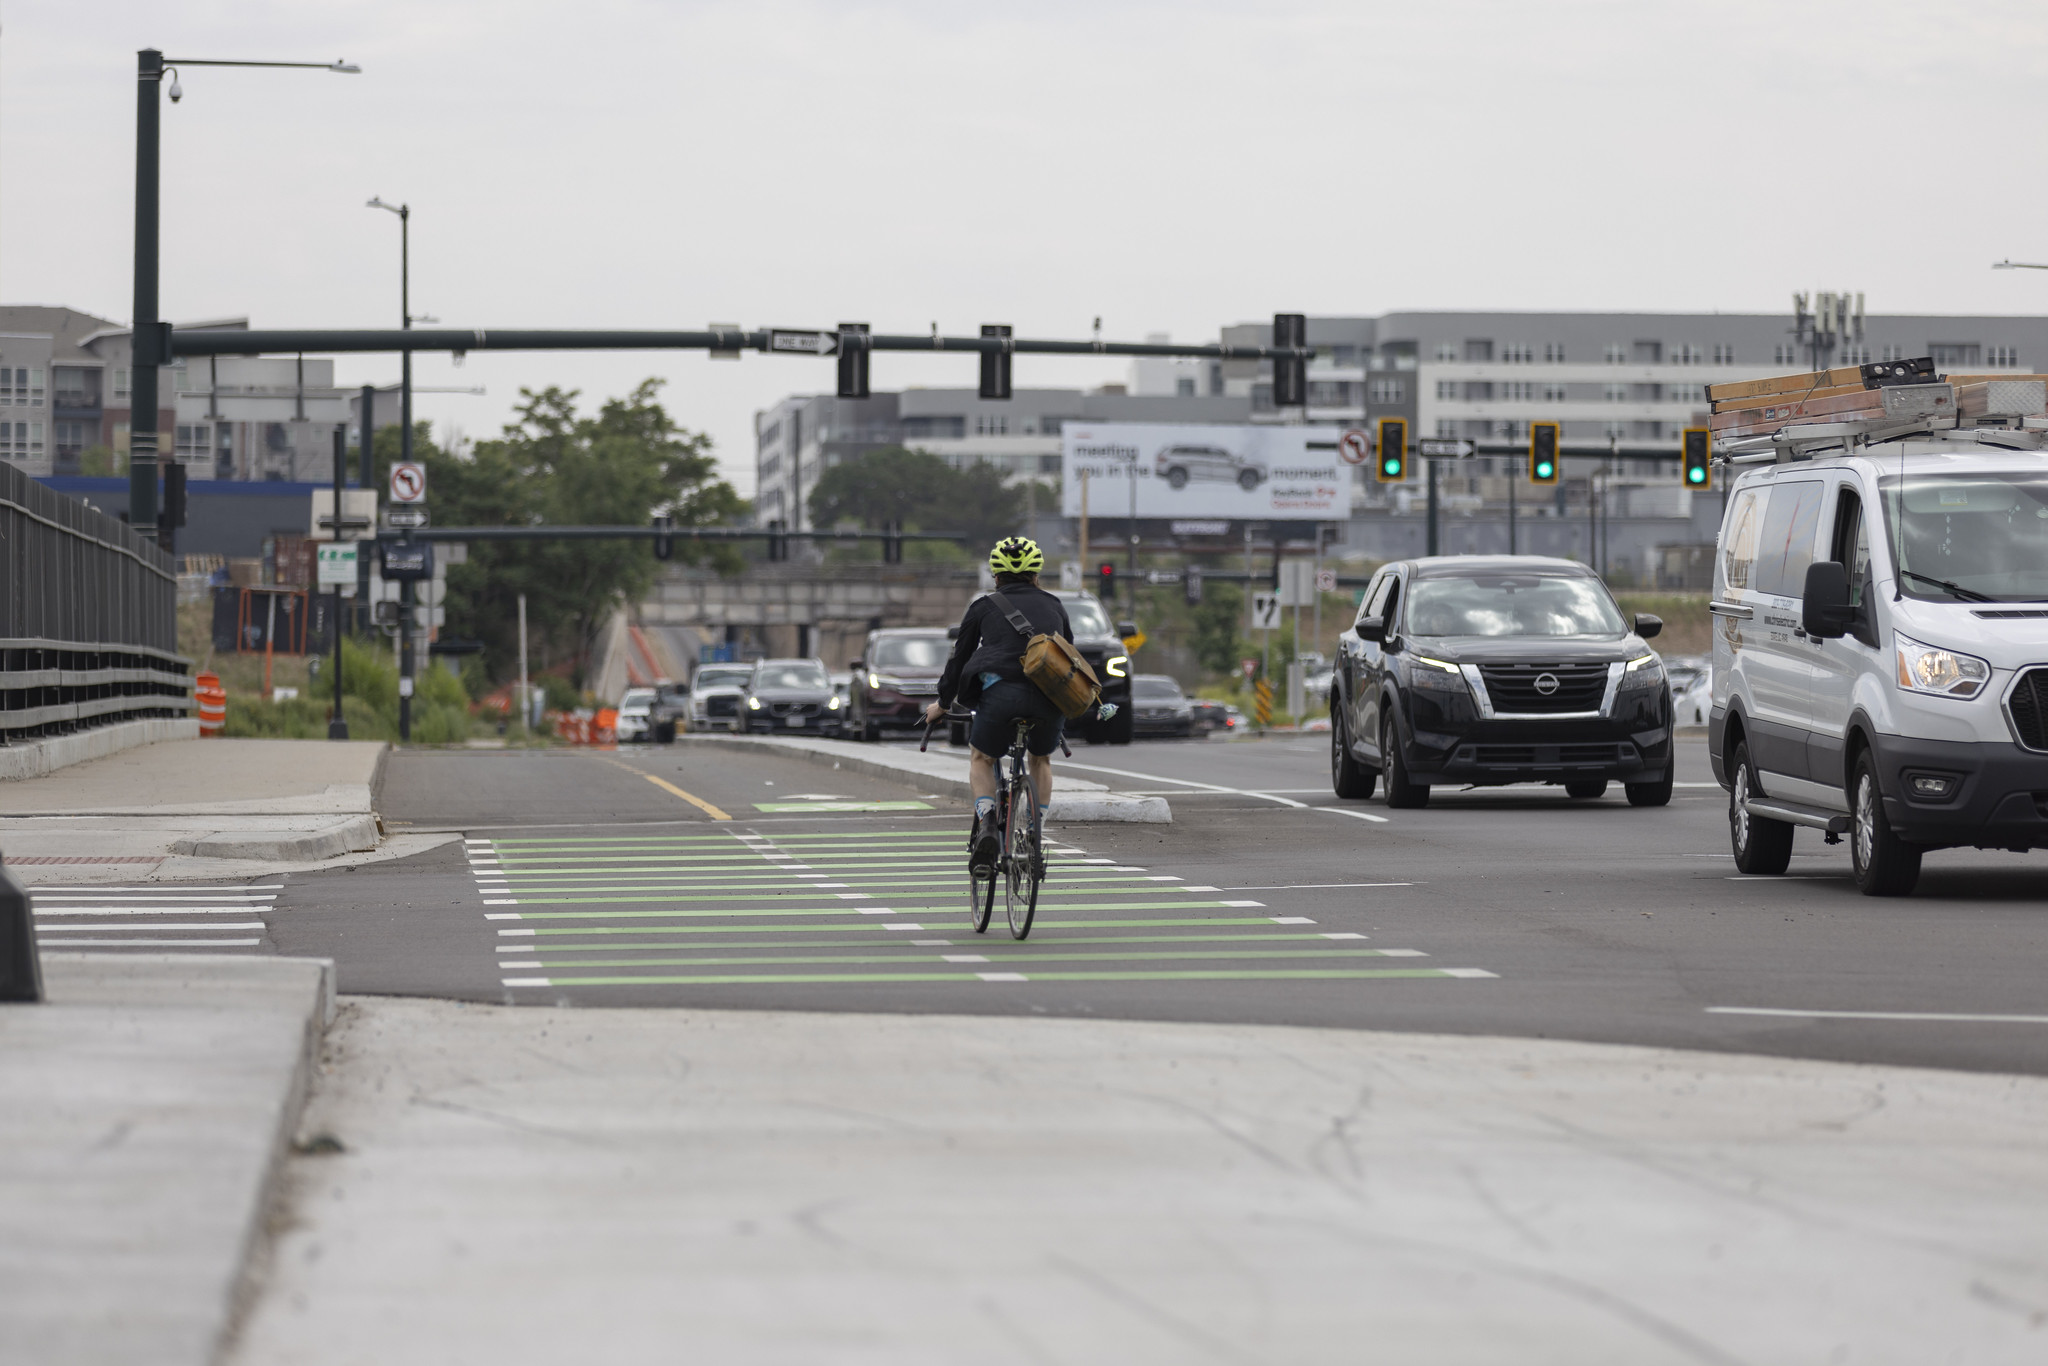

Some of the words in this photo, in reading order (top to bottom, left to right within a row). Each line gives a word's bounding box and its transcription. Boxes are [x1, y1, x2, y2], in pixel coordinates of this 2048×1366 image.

[1076, 442, 1139, 463] meeting
[1075, 466, 1104, 482] you
[1108, 463, 1121, 478] in
[1126, 463, 1150, 479] the
